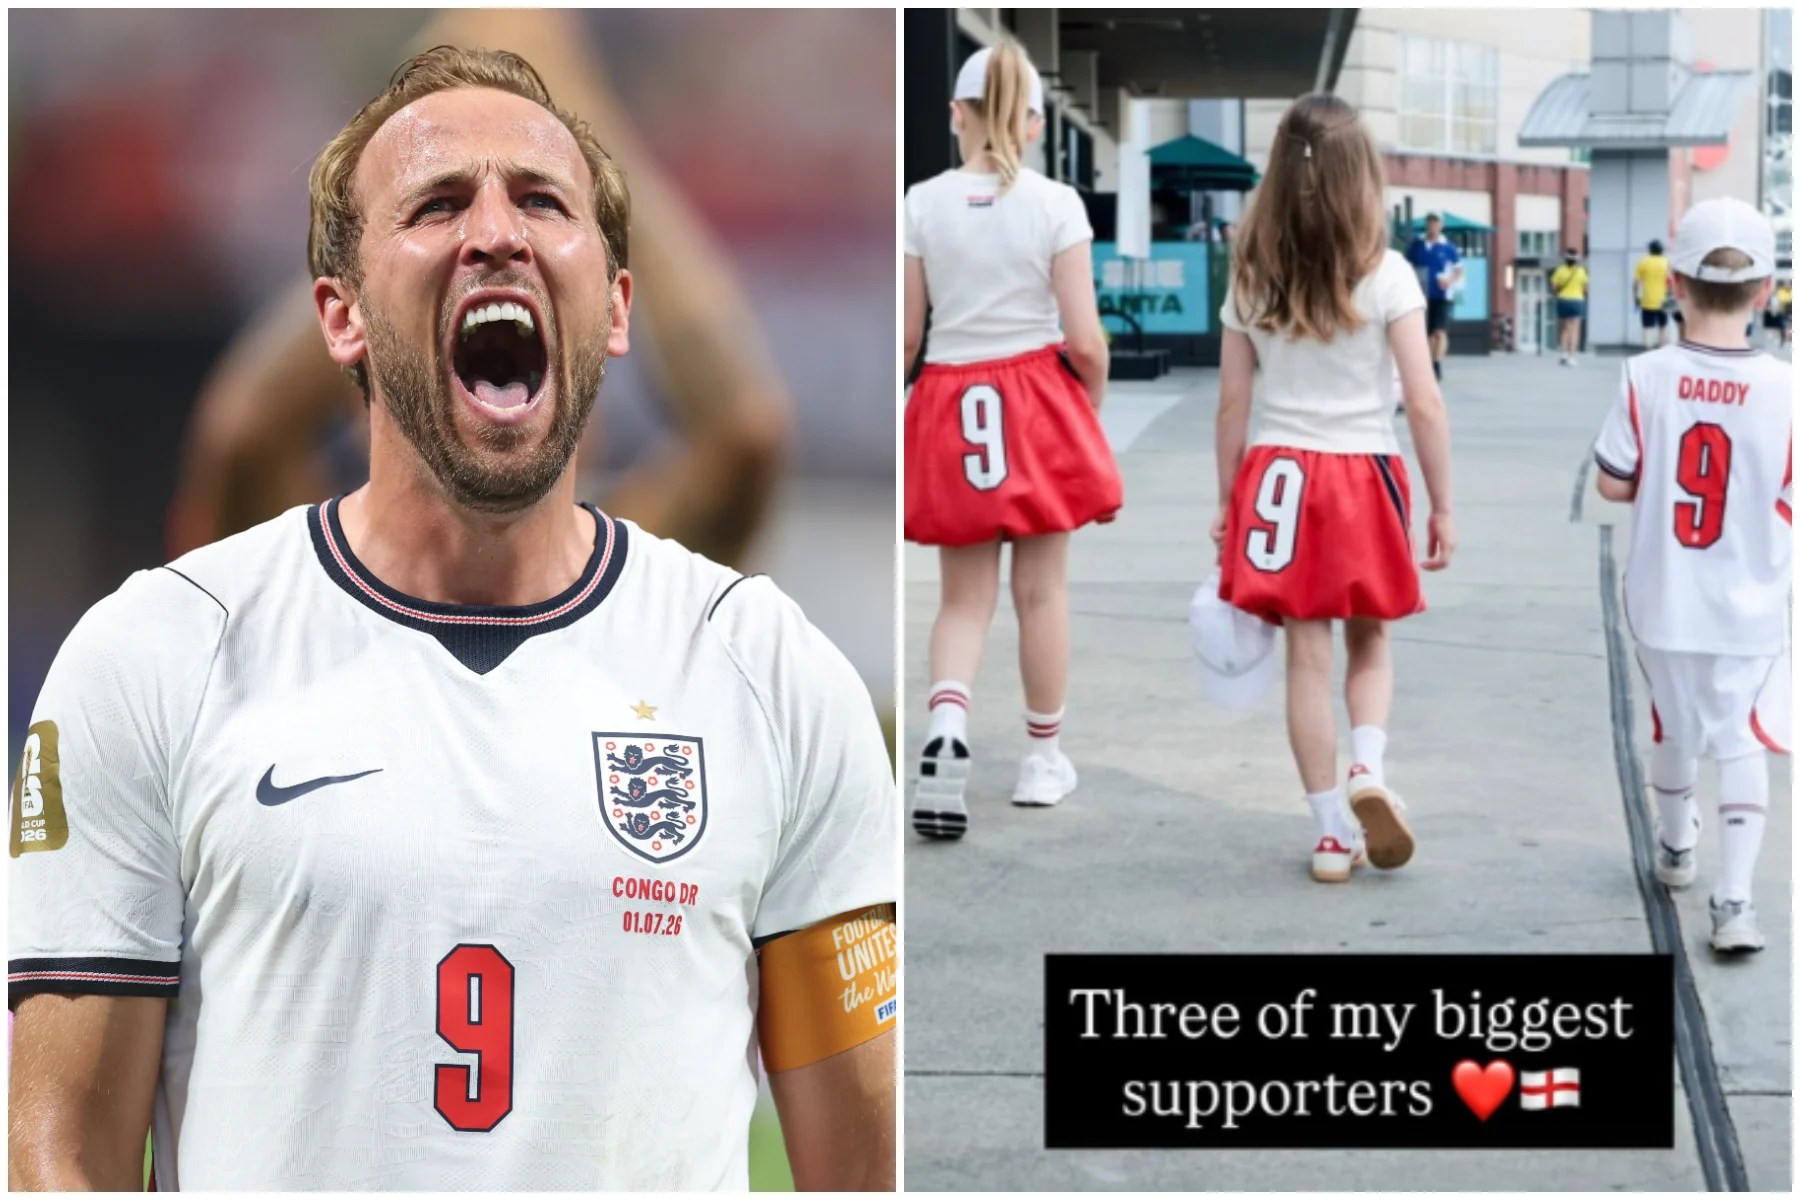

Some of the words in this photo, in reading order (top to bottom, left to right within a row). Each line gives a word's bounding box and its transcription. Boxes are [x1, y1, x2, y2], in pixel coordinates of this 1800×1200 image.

[1678, 376, 1750, 406] DADDY
[960, 383, 1009, 491] 9
[1674, 420, 1732, 550] 9
[1244, 456, 1305, 573] 9
[31, 819, 46, 827] CUP
[612, 876, 676, 902] CONGO
[679, 882, 699, 905] DR
[622, 911, 682, 935] 01.07.26
[838, 981, 874, 1013] the
[434, 943, 515, 1132] 9
